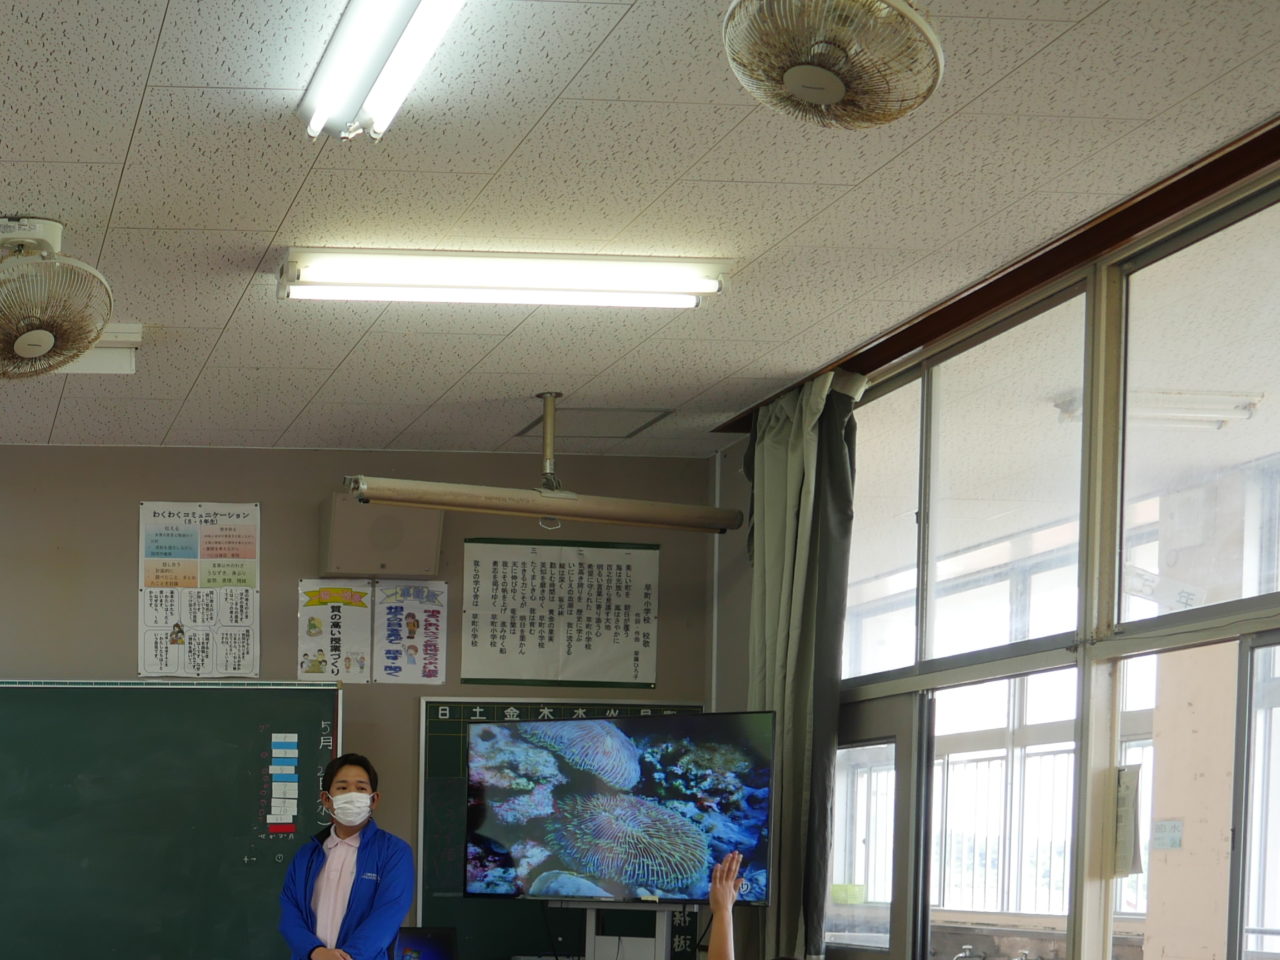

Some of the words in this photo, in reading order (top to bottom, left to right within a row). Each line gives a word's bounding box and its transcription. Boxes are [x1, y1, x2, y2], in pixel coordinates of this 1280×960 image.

[153, 510, 250, 519] わくわくコミュニケーション
[472, 560, 480, 607] 我らの学び舎は
[643, 583, 652, 624] 早町小学校
[330, 605, 341, 676] 質の高い授業づくり
[471, 613, 479, 647] 早町小学校
[537, 615, 545, 649] 早町小学校
[438, 706, 450, 719] 日
[470, 706, 487, 719] 土
[503, 706, 520, 720] 金
[538, 706, 554, 719] 木
[572, 708, 587, 718] 水
